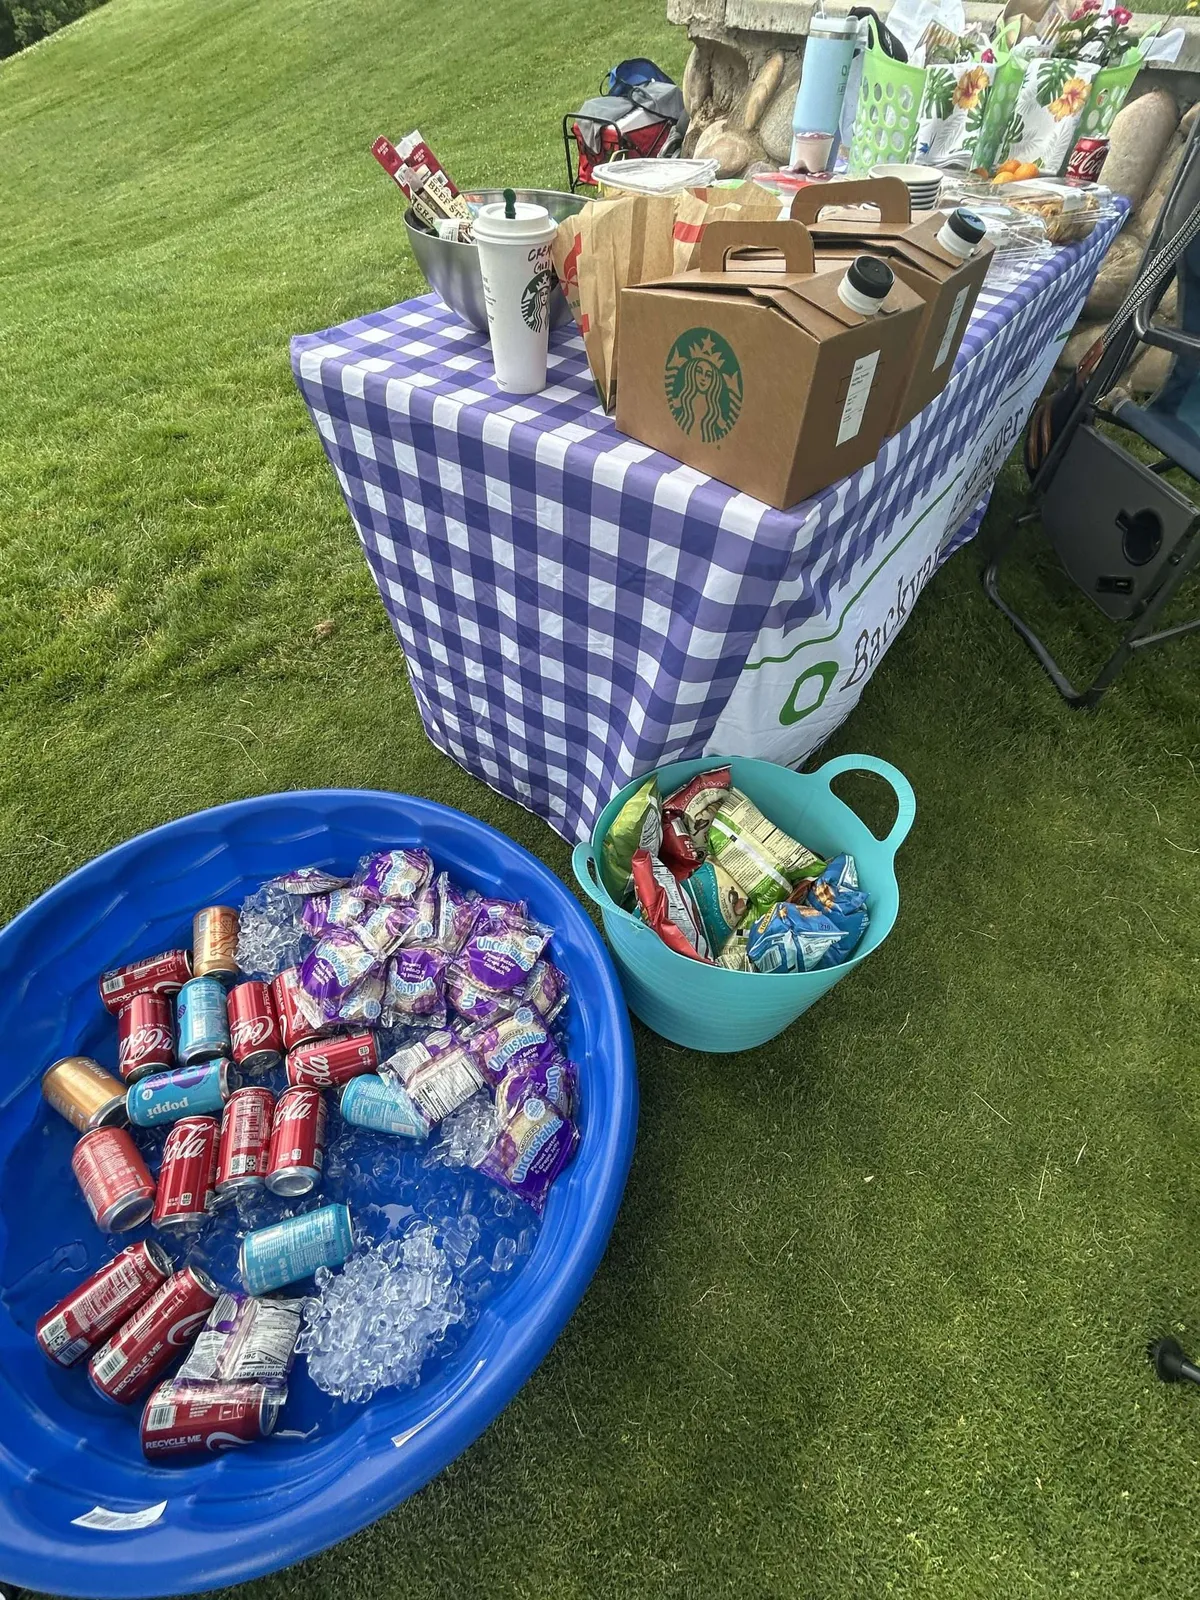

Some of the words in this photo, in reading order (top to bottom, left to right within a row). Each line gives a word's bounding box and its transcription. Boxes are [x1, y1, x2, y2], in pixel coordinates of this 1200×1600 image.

[428, 181, 451, 205] BEEF
[415, 202, 434, 224] GRA
[477, 936, 532, 971] Uncrustables
[107, 991, 138, 1005] RECYCLE
[488, 1031, 546, 1071] Uncrustables
[146, 1096, 189, 1119] poppi
[513, 1117, 562, 1182] Uncrustables
[134, 1252, 149, 1271] Coke
[112, 1358, 150, 1395] RECYCLE
[148, 1342, 163, 1356] ME
[145, 1437, 186, 1449] RECYCLE
[187, 1434, 201, 1443] ME
